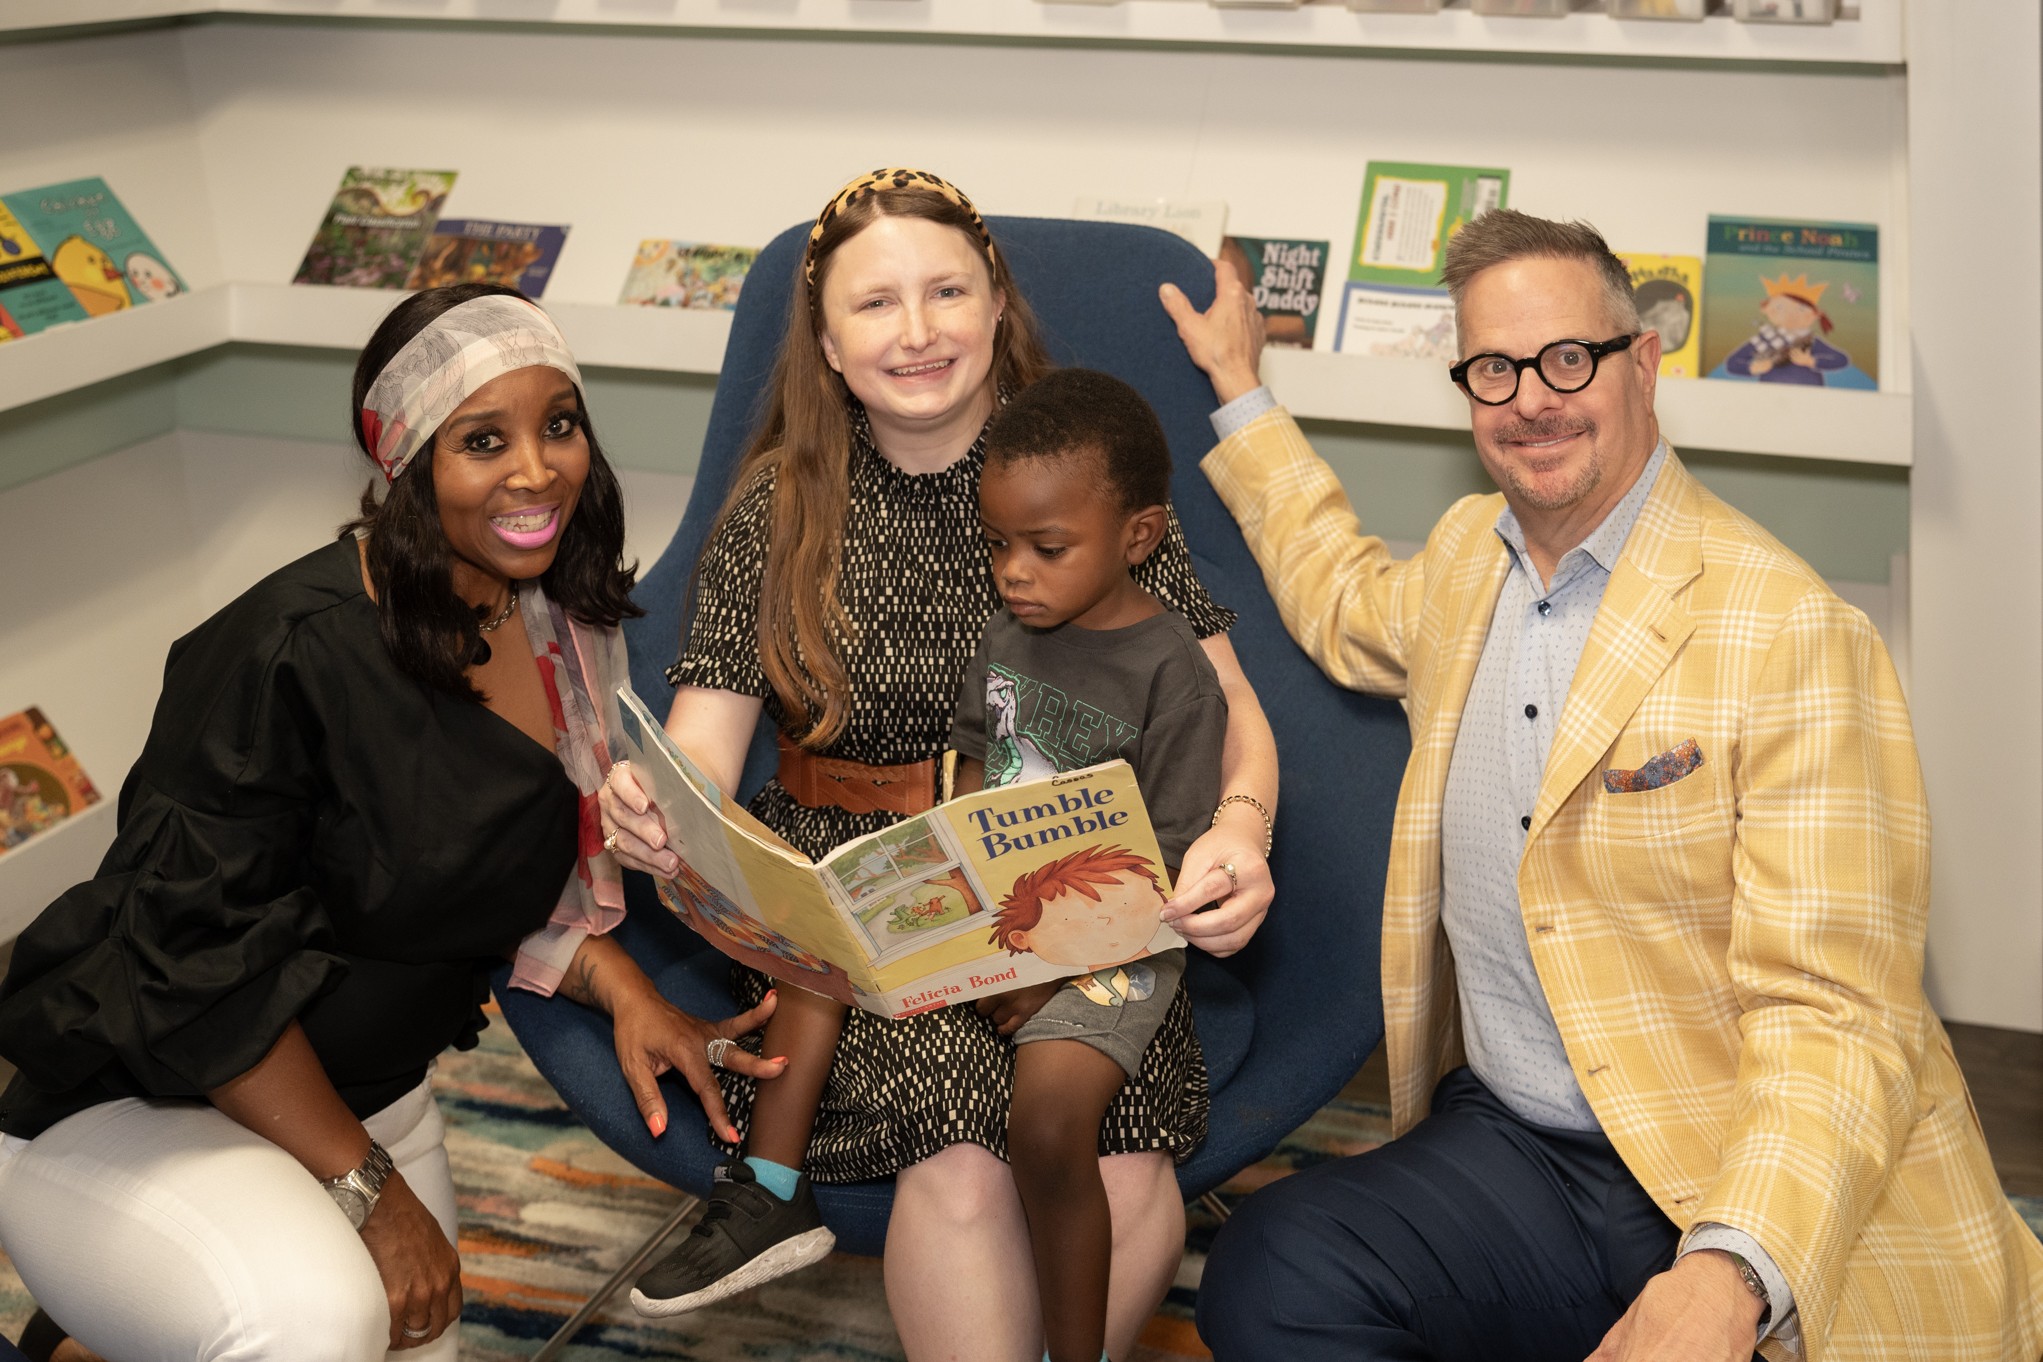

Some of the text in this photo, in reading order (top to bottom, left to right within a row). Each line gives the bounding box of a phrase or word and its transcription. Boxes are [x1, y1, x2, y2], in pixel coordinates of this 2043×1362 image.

[463, 221, 541, 241] THE PARTY
[1723, 223, 1858, 247] Prince Noah
[1262, 242, 1321, 269] Night
[1261, 266, 1315, 291] Shift
[1253, 286, 1319, 316] Daddy
[968, 787, 1115, 835] Tumble
[976, 810, 1129, 861] Bumble
[901, 967, 1018, 1009] Felicia Bond
